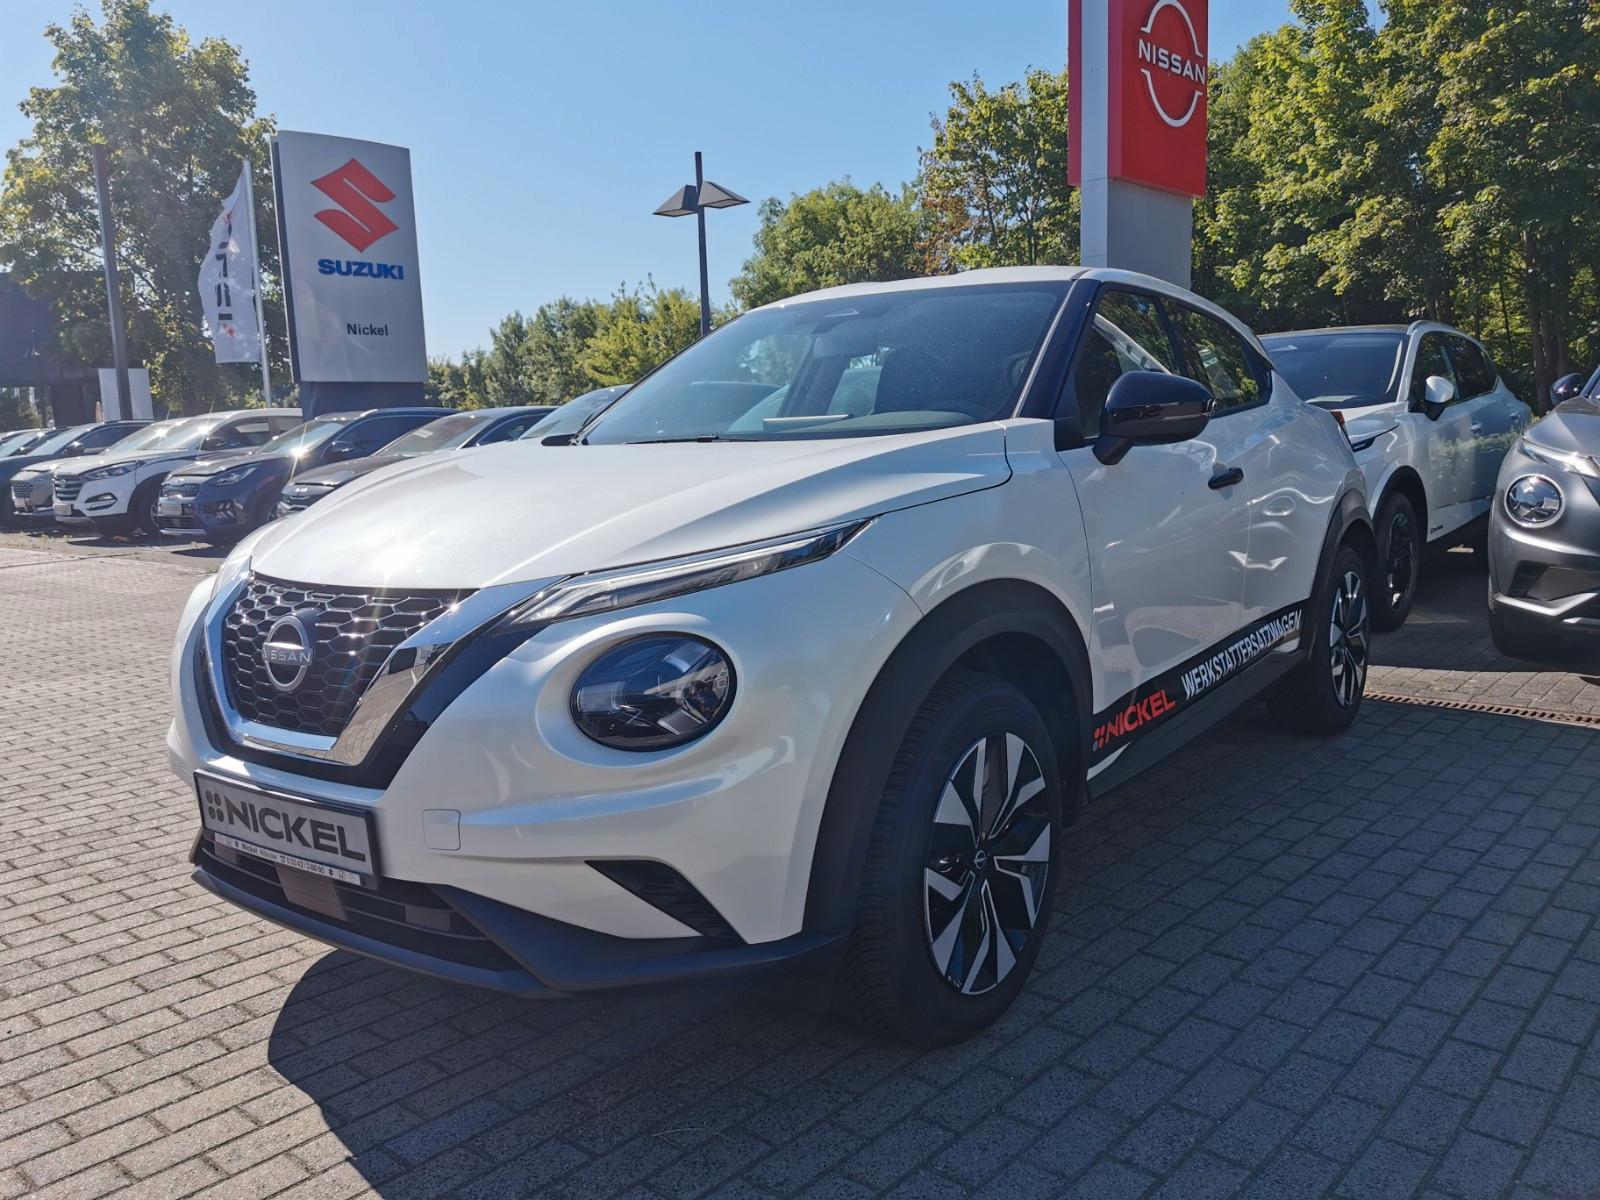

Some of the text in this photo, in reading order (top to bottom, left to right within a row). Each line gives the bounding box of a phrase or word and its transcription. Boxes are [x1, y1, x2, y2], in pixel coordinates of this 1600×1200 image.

[1138, 38, 1206, 85] NISSAN
[318, 258, 404, 281] SUZUKI
[347, 323, 389, 337] Nickel
[1105, 608, 1302, 743] NICKEL WERKSTATTERSATZWAGEN
[223, 795, 367, 863] NICKEL
